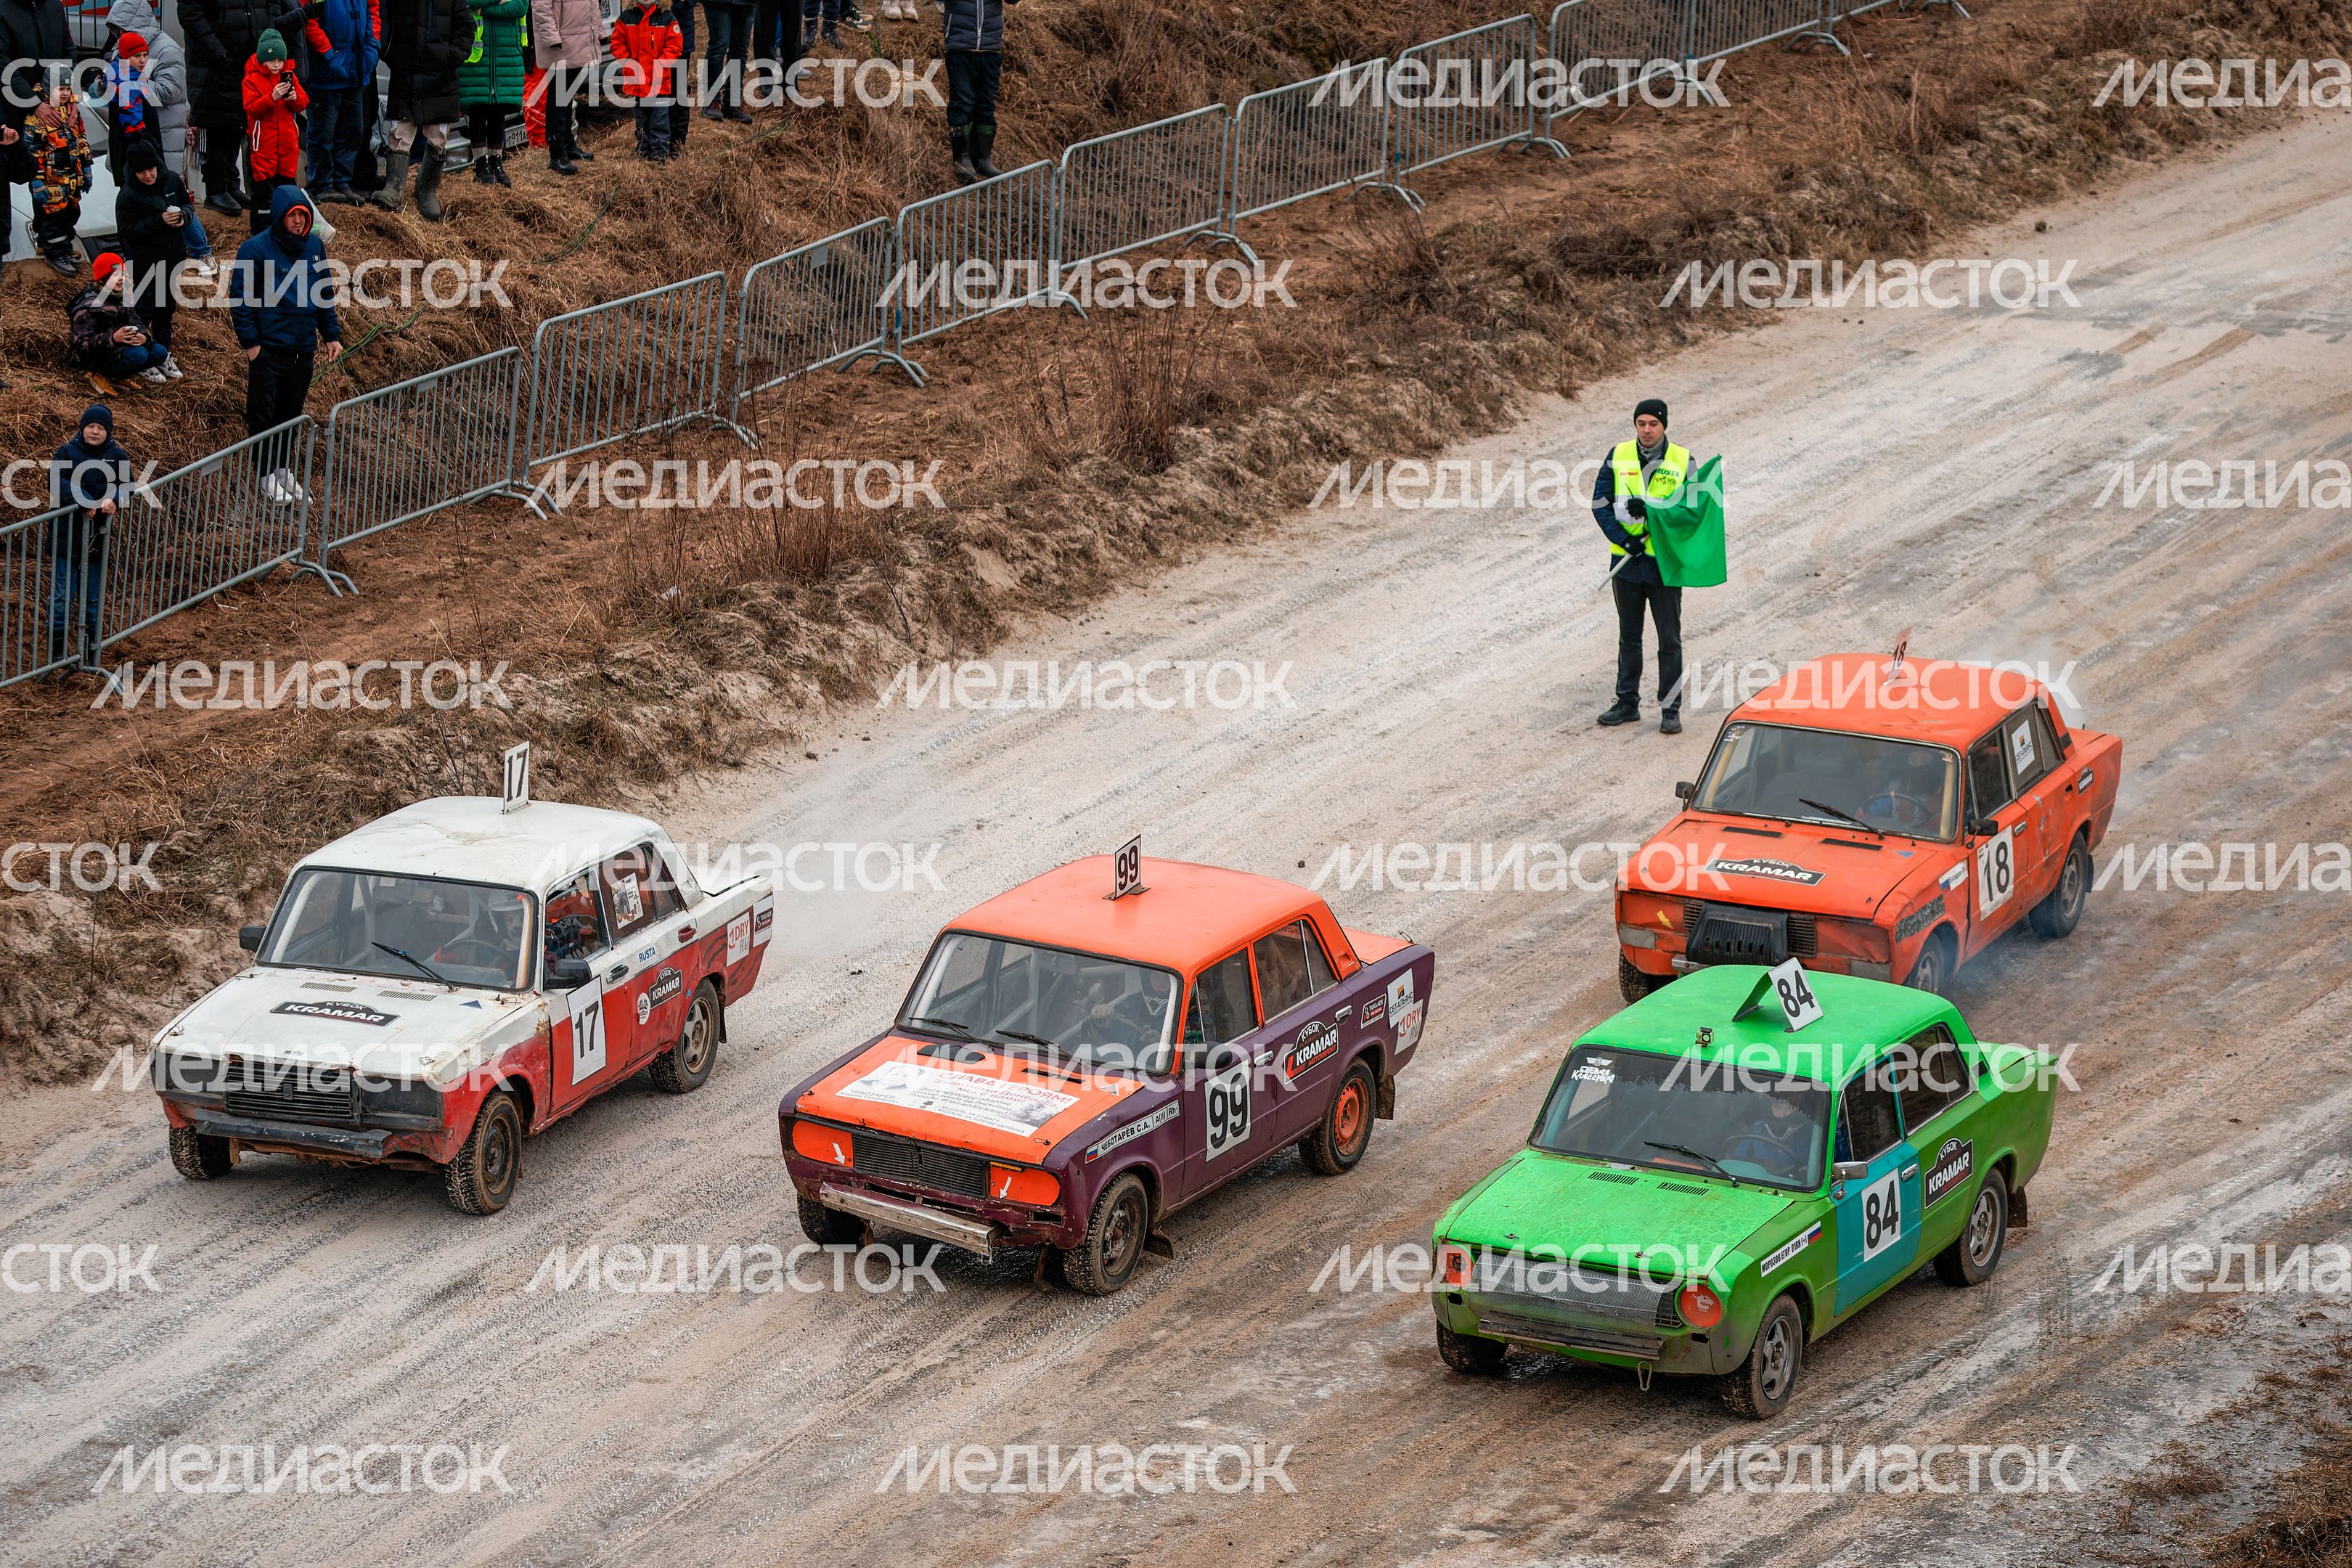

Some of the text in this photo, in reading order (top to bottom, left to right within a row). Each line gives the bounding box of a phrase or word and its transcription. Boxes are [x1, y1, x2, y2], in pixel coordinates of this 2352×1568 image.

[1892, 640, 1907, 671] 18
[507, 748, 528, 802] 17
[1117, 845, 1138, 891] 99
[1716, 862, 1813, 881] KRAMAR
[1983, 841, 2009, 902] 18
[729, 919, 748, 945] 1DRY
[740, 935, 749, 953] RU
[638, 947, 656, 963] RUSTA
[652, 976, 679, 1001] KRAMAR
[1777, 969, 1815, 1018] 84
[285, 1004, 385, 1022] KRAMAR
[325, 1001, 367, 1010] КУБОК
[575, 1000, 599, 1058] 17
[1301, 1023, 1320, 1042] КУБОК
[1400, 1006, 1421, 1034] 1DRY
[1410, 1024, 1420, 1041] RU
[1296, 1029, 1337, 1066] KRAMAR
[939, 1072, 1072, 1104] СЛАВА ГЕРОЯМ!
[1209, 1072, 1248, 1149] 99
[1101, 1122, 1151, 1151] ЧЕБОТАРЁВ С.А.
[1940, 1140, 1958, 1161] КУБОК
[1929, 1151, 1969, 1195] KRAMAR
[1866, 1180, 1899, 1249] 84
[1761, 1253, 1781, 1273] МОРОЗОВ
[1781, 1246, 1790, 1260] ЕГОР
